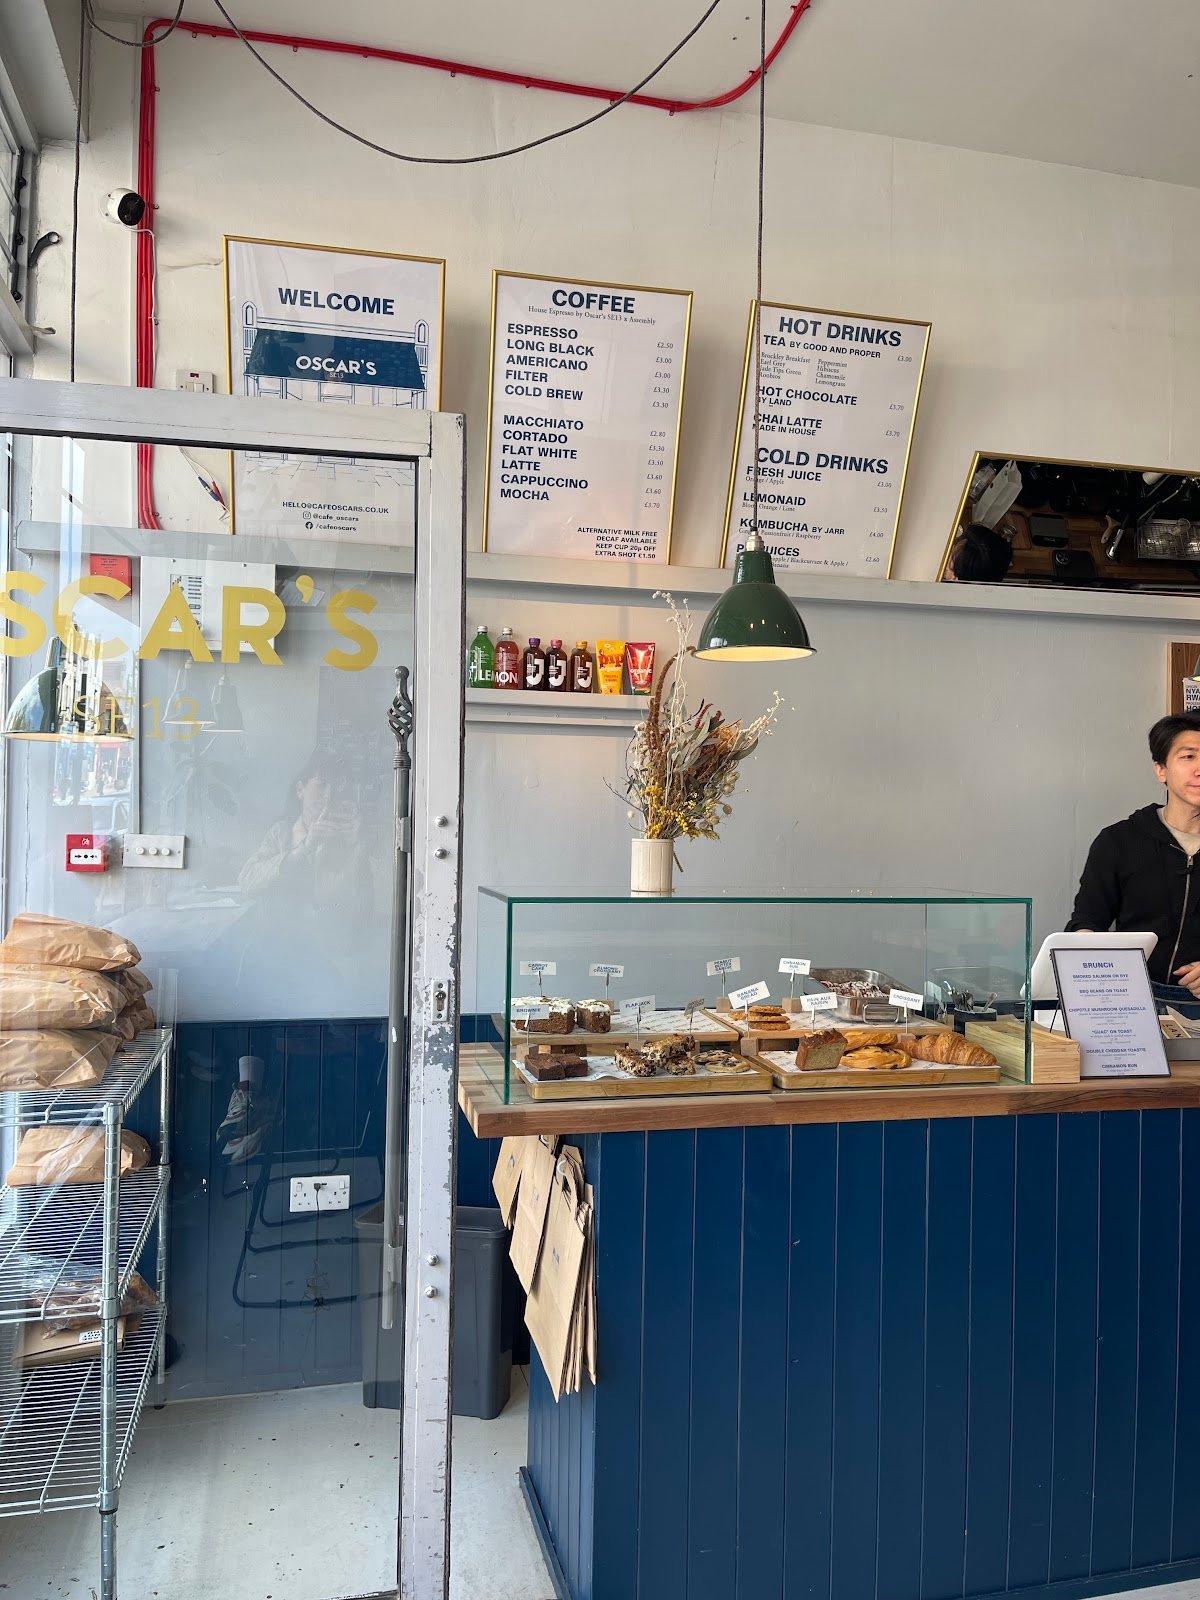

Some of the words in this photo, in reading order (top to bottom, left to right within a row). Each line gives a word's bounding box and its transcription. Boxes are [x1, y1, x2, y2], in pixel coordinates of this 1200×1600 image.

[278, 287, 395, 316] WELCOME
[551, 289, 636, 314] COFFEE
[528, 305, 548, 314] House
[549, 308, 574, 317] Espresso
[575, 309, 583, 318] by
[584, 311, 606, 320] Oscar's
[607, 314, 622, 322] SE13
[629, 316, 656, 326] Assembly
[507, 323, 578, 339] ESPRESSO
[779, 316, 822, 337] HOT
[826, 322, 902, 347] DRINKS
[507, 339, 545, 352] LONG
[549, 343, 595, 357] BLACK
[656, 341, 673, 349] £2.50
[763, 334, 786, 347] TEA
[789, 340, 801, 348] BY
[803, 343, 828, 352] GOOD
[829, 346, 847, 355] AND
[849, 348, 881, 358] PROPER
[506, 354, 588, 371] AMERICANO
[655, 356, 672, 364] £3.00
[761, 352, 784, 361] Brockley
[785, 355, 811, 363] Breakfast
[772, 360, 786, 368] Grey
[817, 359, 848, 368] Peppermint
[295, 355, 377, 376] OSCAR'S
[772, 366, 785, 374] Tips
[785, 368, 802, 376] Green
[816, 365, 840, 374] Hibiscus
[505, 369, 548, 383] FILTER
[654, 371, 671, 379] £3.00
[815, 372, 846, 381] Chamomile
[815, 378, 846, 387] Lemongrass
[504, 384, 542, 397] COLD
[546, 388, 583, 401] BREW
[758, 385, 783, 397] HOT
[785, 388, 858, 406] CHOCOLATE
[769, 397, 792, 406] LAND
[503, 415, 584, 430] MACCHIATO
[753, 412, 783, 425] CHAI
[786, 416, 823, 429] LATTE
[503, 430, 568, 444] CORTADO
[788, 427, 817, 436] HOUSE
[502, 444, 534, 457] FLAT
[537, 447, 578, 460] WHITE
[501, 459, 541, 471] LATTE
[756, 447, 810, 466] COLD
[815, 453, 889, 474] DRINKS
[500, 473, 589, 489] CAPPUCCINO
[646, 473, 663, 481] £3.60
[769, 478, 785, 486] Apple
[787, 470, 822, 482] JUICE
[500, 488, 549, 501] MOCHA
[743, 492, 806, 506] LEMONAID
[282, 501, 389, 514] HELLO@CAFEOSCARS.CO.UK
[758, 503, 778, 511] Orange
[312, 513, 359, 522] @cafe_oscars
[315, 523, 357, 531] /cafeoscars
[577, 527, 622, 535] ALTERNATIVE
[740, 518, 809, 532] KOMBUCHA
[824, 527, 845, 535] JARR
[760, 530, 792, 538] Passionfruit
[795, 532, 822, 540] Raspberry
[0, 570, 379, 672] SCAR'S
